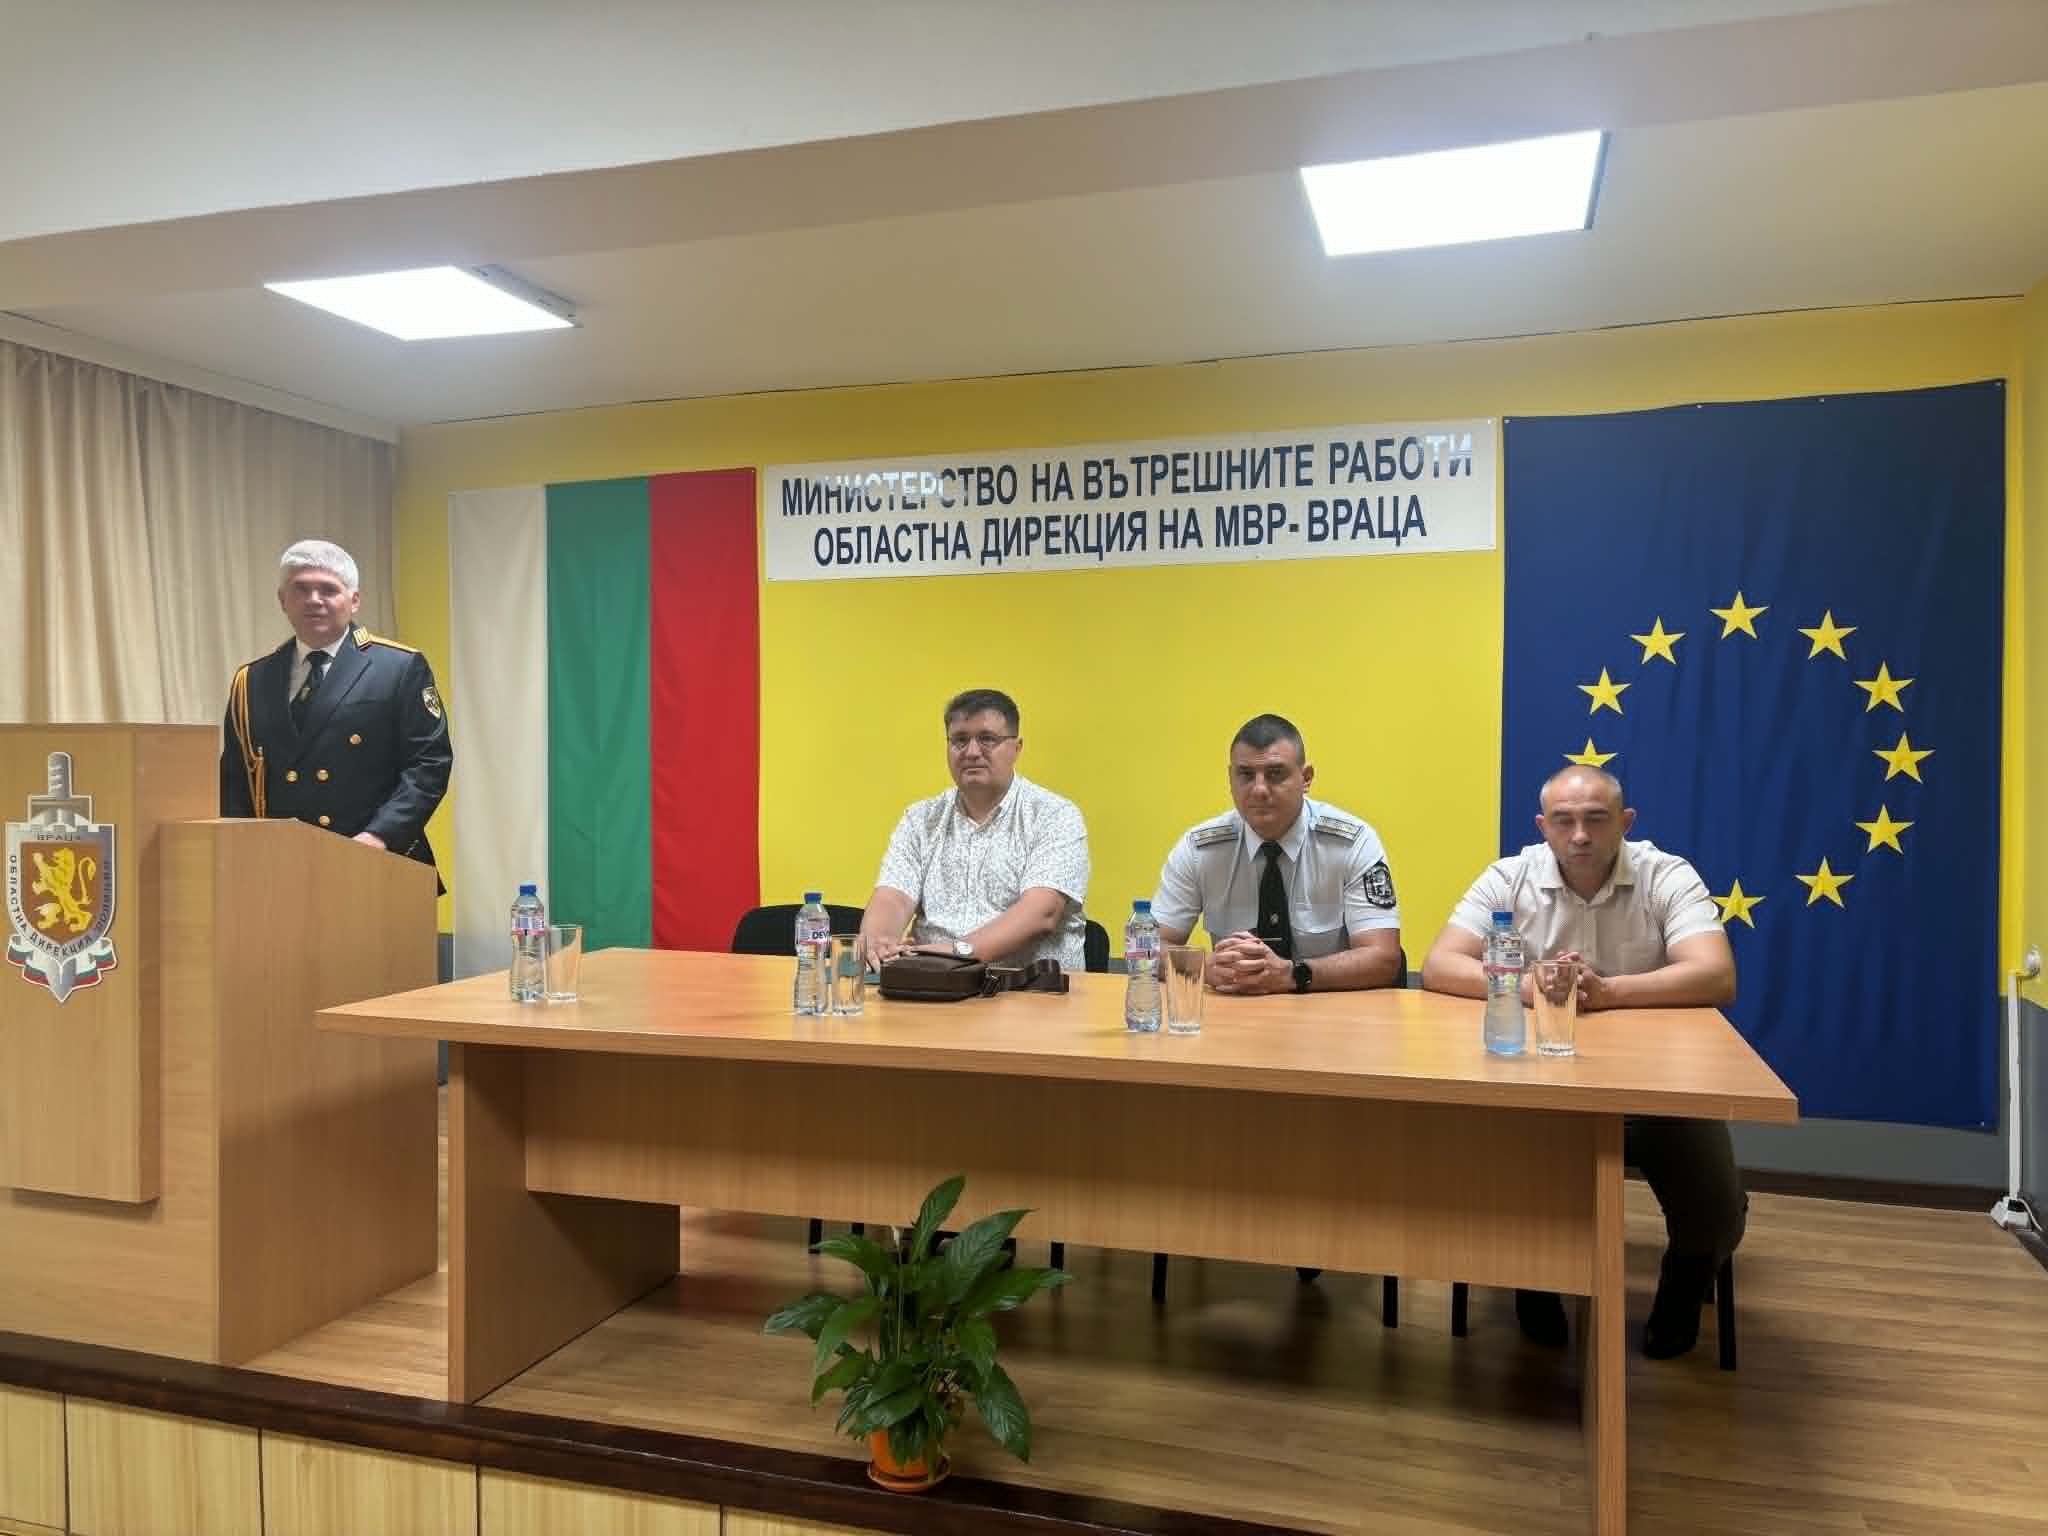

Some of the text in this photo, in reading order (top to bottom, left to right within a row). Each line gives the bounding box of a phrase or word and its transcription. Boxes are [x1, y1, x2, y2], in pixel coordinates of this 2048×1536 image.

[782, 432, 1473, 517] МИНИСТЕРСТВО НА ВЪТРЕШНИТЕ РАБОТИ
[813, 520, 972, 567] ОБЛАСТНА
[980, 509, 1148, 566] ДИРЕКЦИЯ
[1159, 507, 1204, 550] НА
[1307, 494, 1428, 547] ВРАЦА
[8, 855, 28, 932] ОБЛАСТНА
